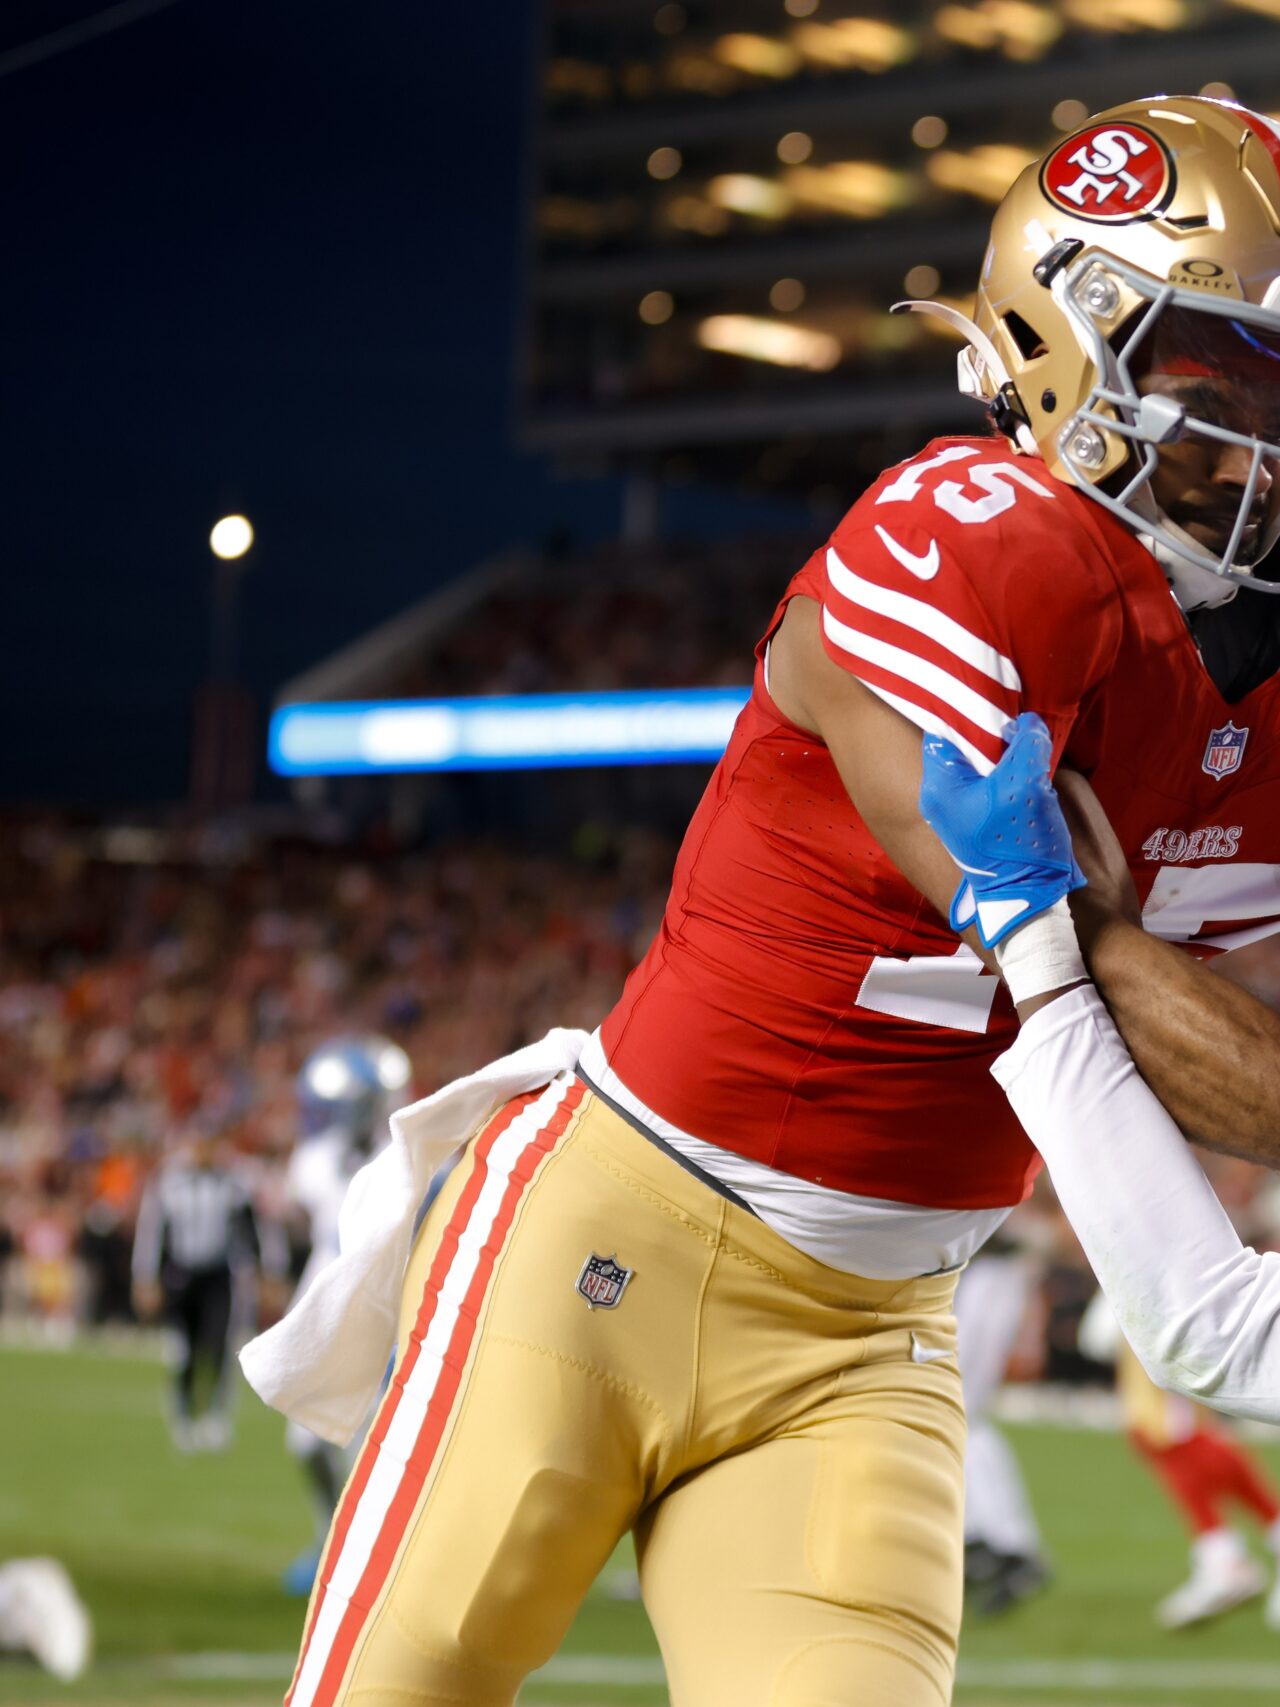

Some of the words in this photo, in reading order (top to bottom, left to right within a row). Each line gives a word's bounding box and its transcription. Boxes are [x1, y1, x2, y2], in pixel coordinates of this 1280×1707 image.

[1169, 274, 1233, 290] OAKLEY
[874, 445, 1056, 524] 15
[1208, 747, 1237, 770] NFL
[1141, 825, 1243, 862] 49ERS
[582, 1271, 618, 1302] NFL
